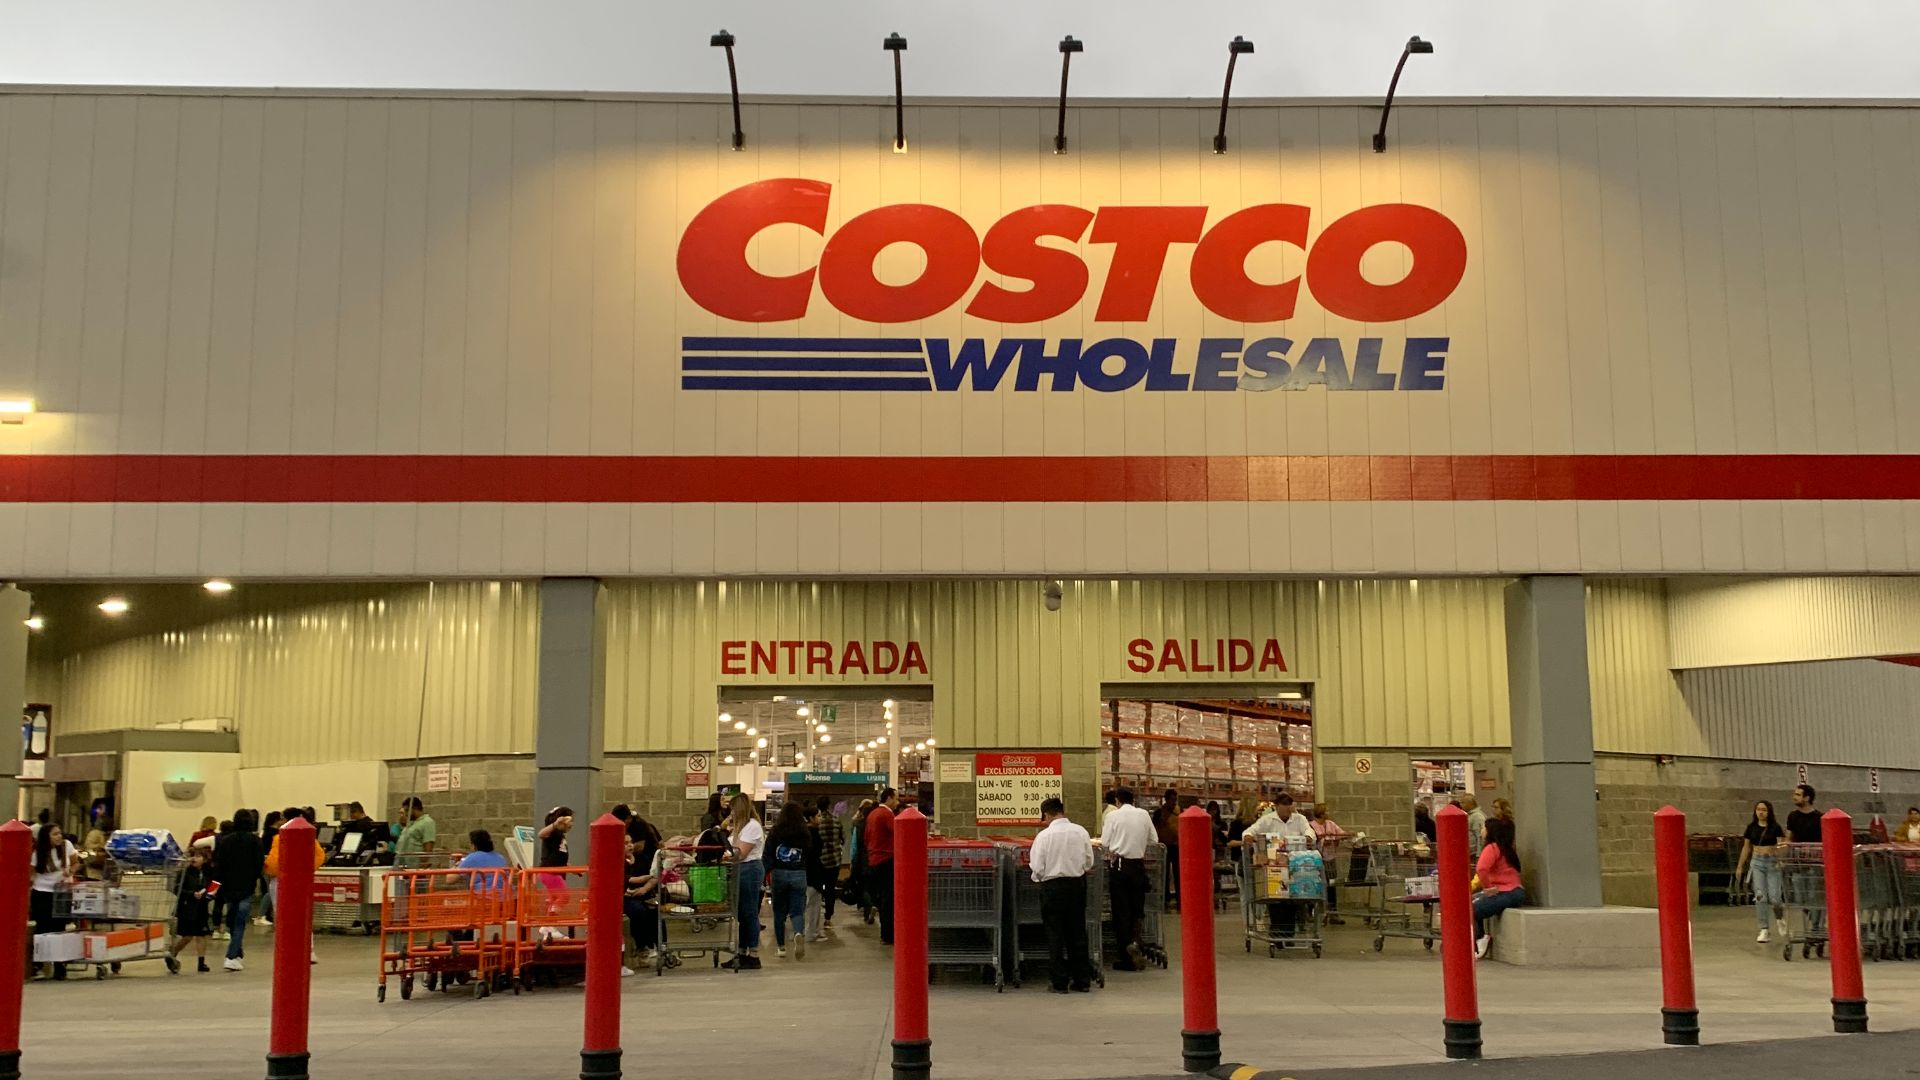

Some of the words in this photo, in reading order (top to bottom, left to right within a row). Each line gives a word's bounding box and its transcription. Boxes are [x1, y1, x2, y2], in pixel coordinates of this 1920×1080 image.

[676, 178, 1467, 323] COSTCO
[924, 337, 1449, 391] WHOLESALE
[721, 640, 928, 674] ENTRADA
[1127, 639, 1287, 672] SALIDA
[984, 767, 1025, 775] EXCLUSIVO
[1026, 767, 1054, 775] SOCIOS
[978, 780, 994, 788] LUN
[1000, 780, 1013, 788] VIE
[1020, 780, 1040, 788] 10:00
[1045, 780, 1060, 788] 8:30
[1024, 793, 1039, 801] 9:30
[978, 807, 1016, 815] DOMINGO
[1021, 807, 1039, 815] 10:00
